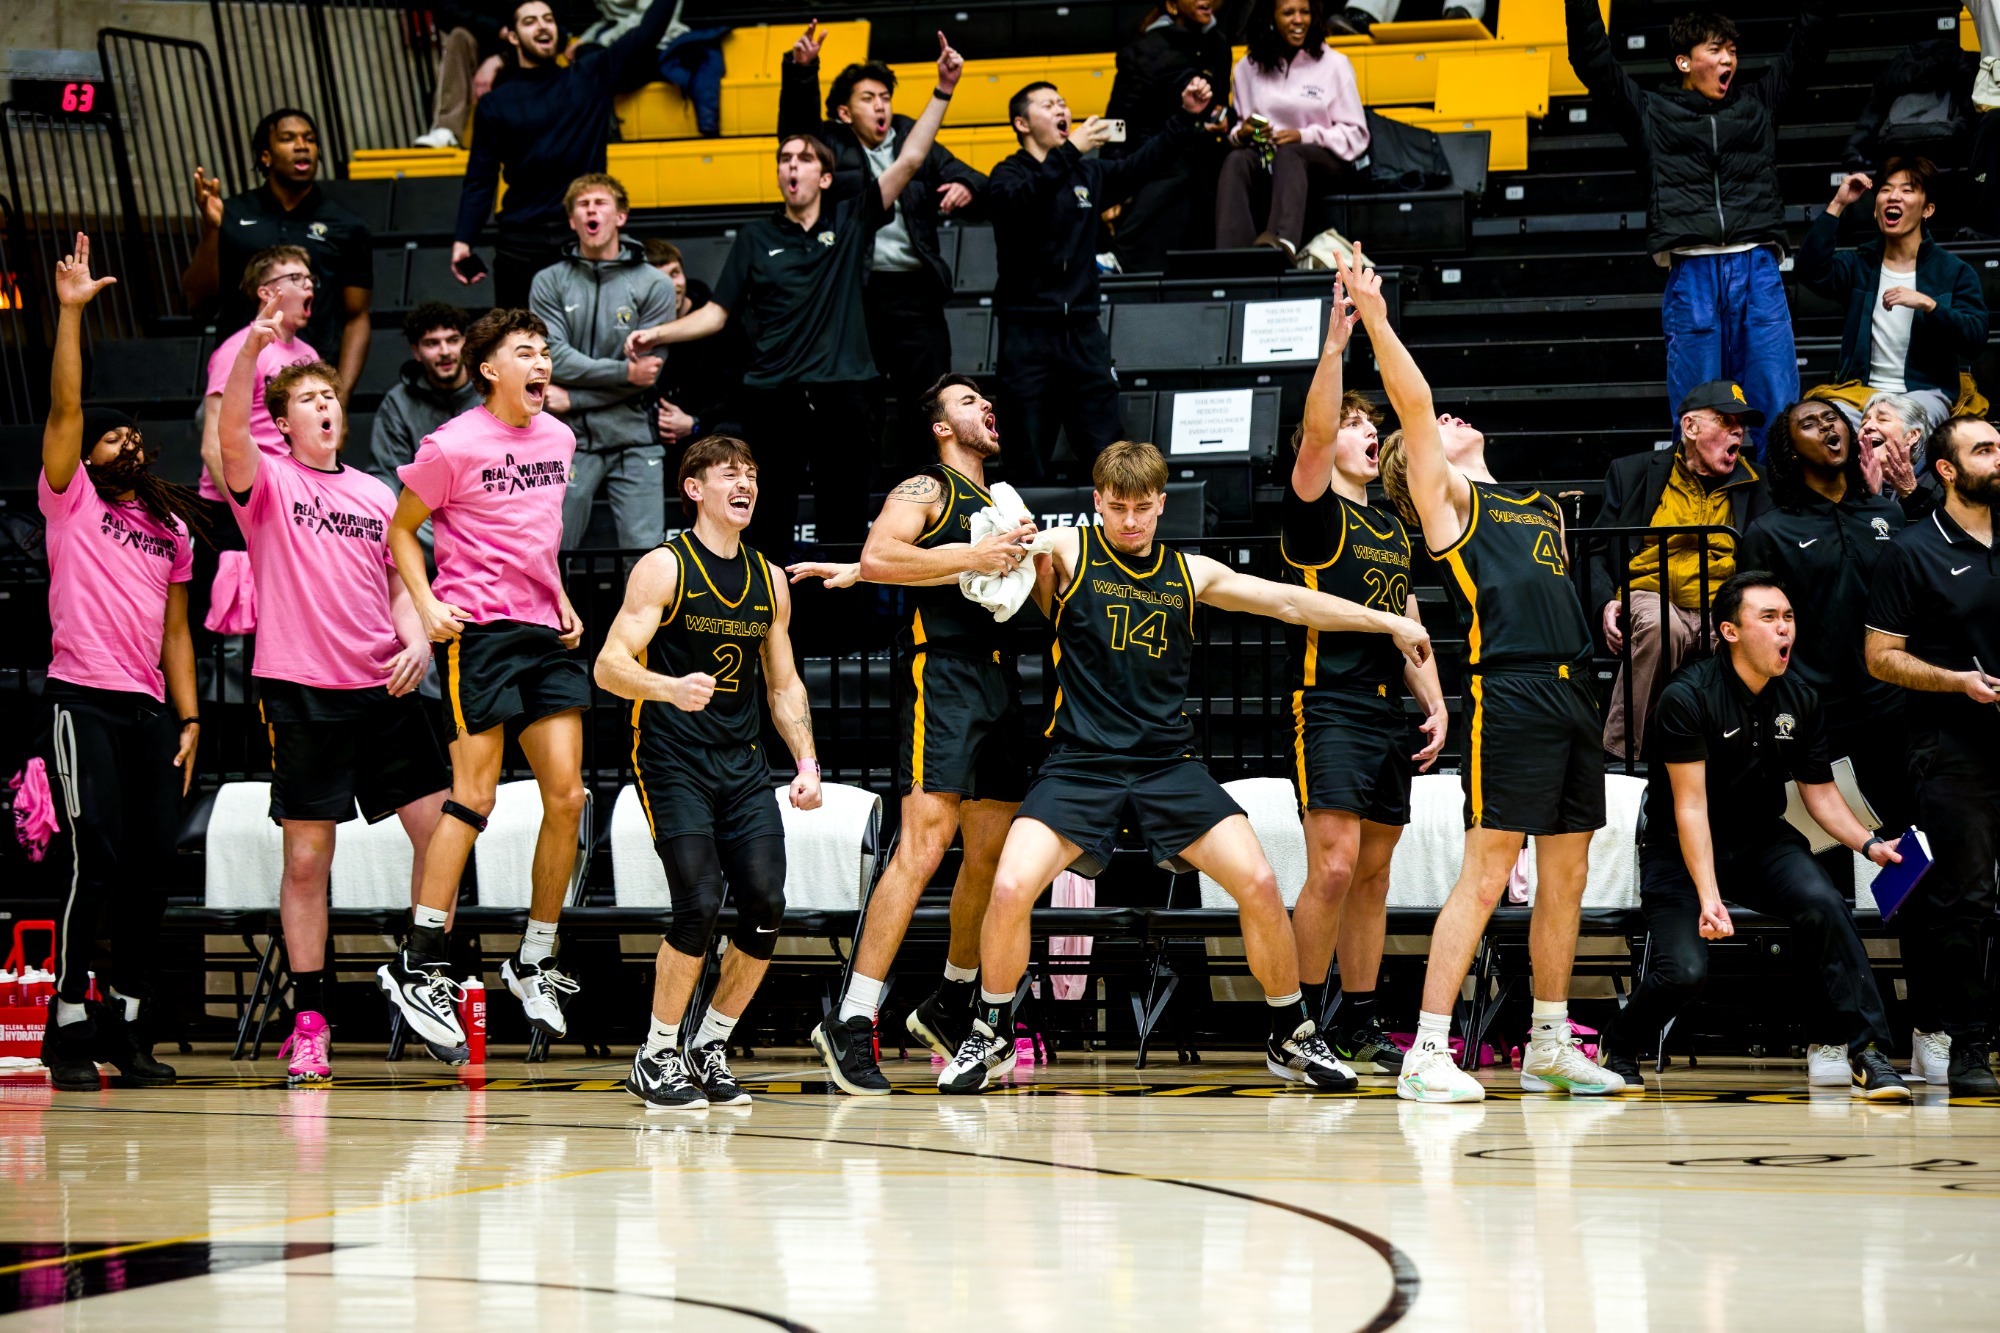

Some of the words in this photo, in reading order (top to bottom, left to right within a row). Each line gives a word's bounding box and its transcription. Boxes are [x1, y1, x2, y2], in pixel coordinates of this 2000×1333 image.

[62, 83, 95, 112] 63
[482, 466, 508, 483] REAL
[517, 460, 565, 478] WARRIORS
[525, 474, 552, 488] WEAR
[552, 472, 567, 485] PINK
[102, 512, 126, 533] RAL
[293, 501, 318, 520] REAL
[329, 511, 384, 532] WARRIORS
[335, 525, 364, 539] WEAR
[366, 530, 383, 543] PINK
[1533, 530, 1565, 576] 4
[1093, 579, 1184, 609] WATERLOO
[1363, 567, 1408, 617] 20
[685, 614, 768, 637] WATERLOO
[1106, 604, 1168, 658] 14
[712, 643, 743, 692] 2
